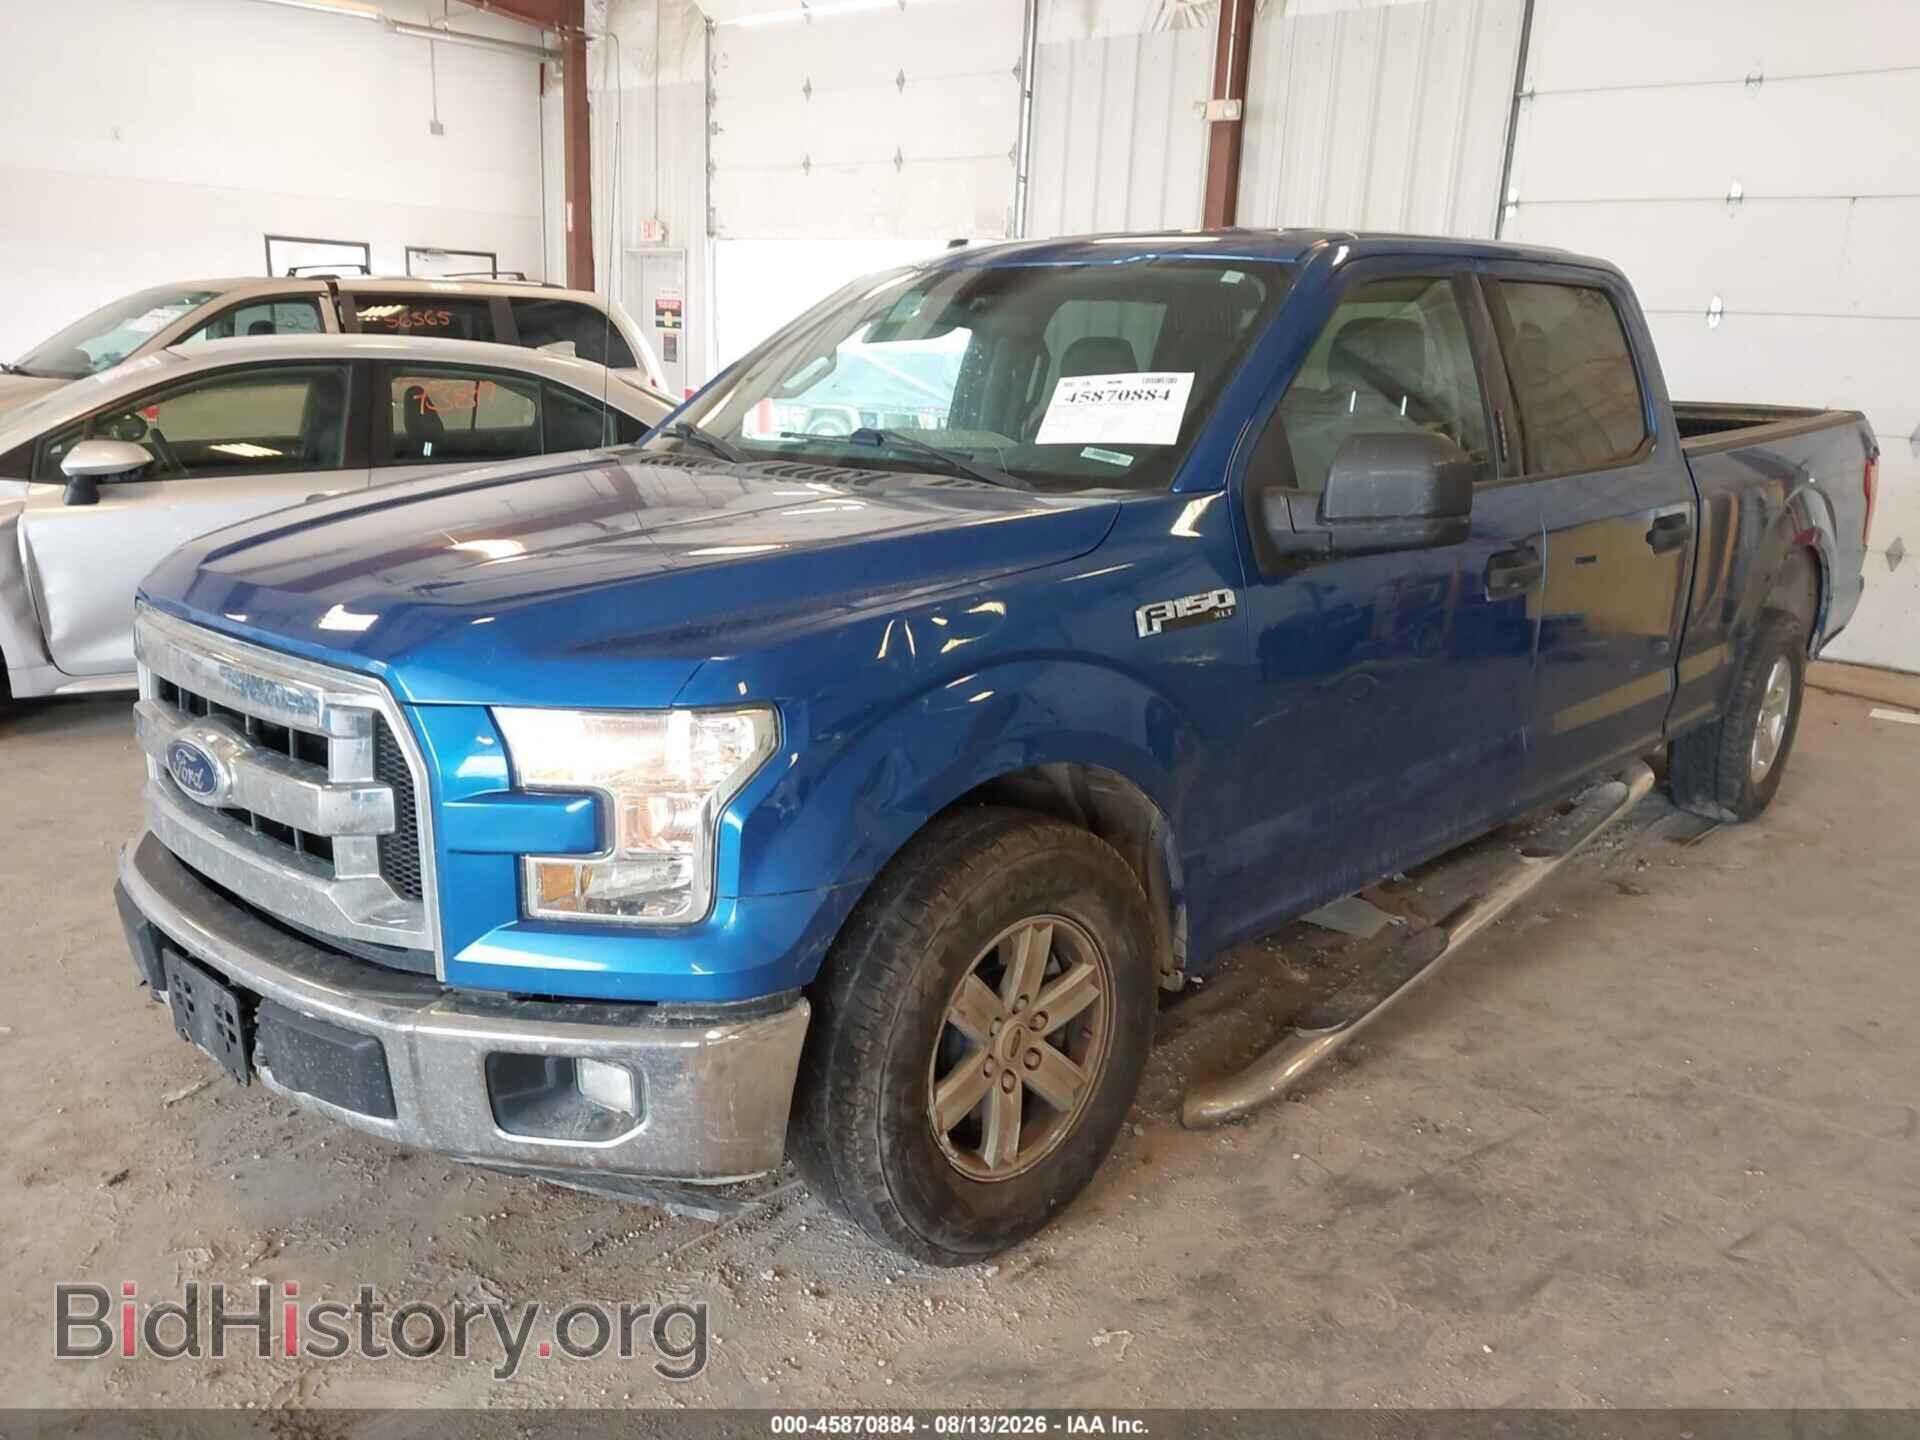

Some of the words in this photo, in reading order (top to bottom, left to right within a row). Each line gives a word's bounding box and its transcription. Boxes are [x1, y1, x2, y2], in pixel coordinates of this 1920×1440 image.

[1064, 389, 1171, 404] 45870884
[1214, 607, 1232, 619] XLT
[173, 748, 204, 789] Ford
